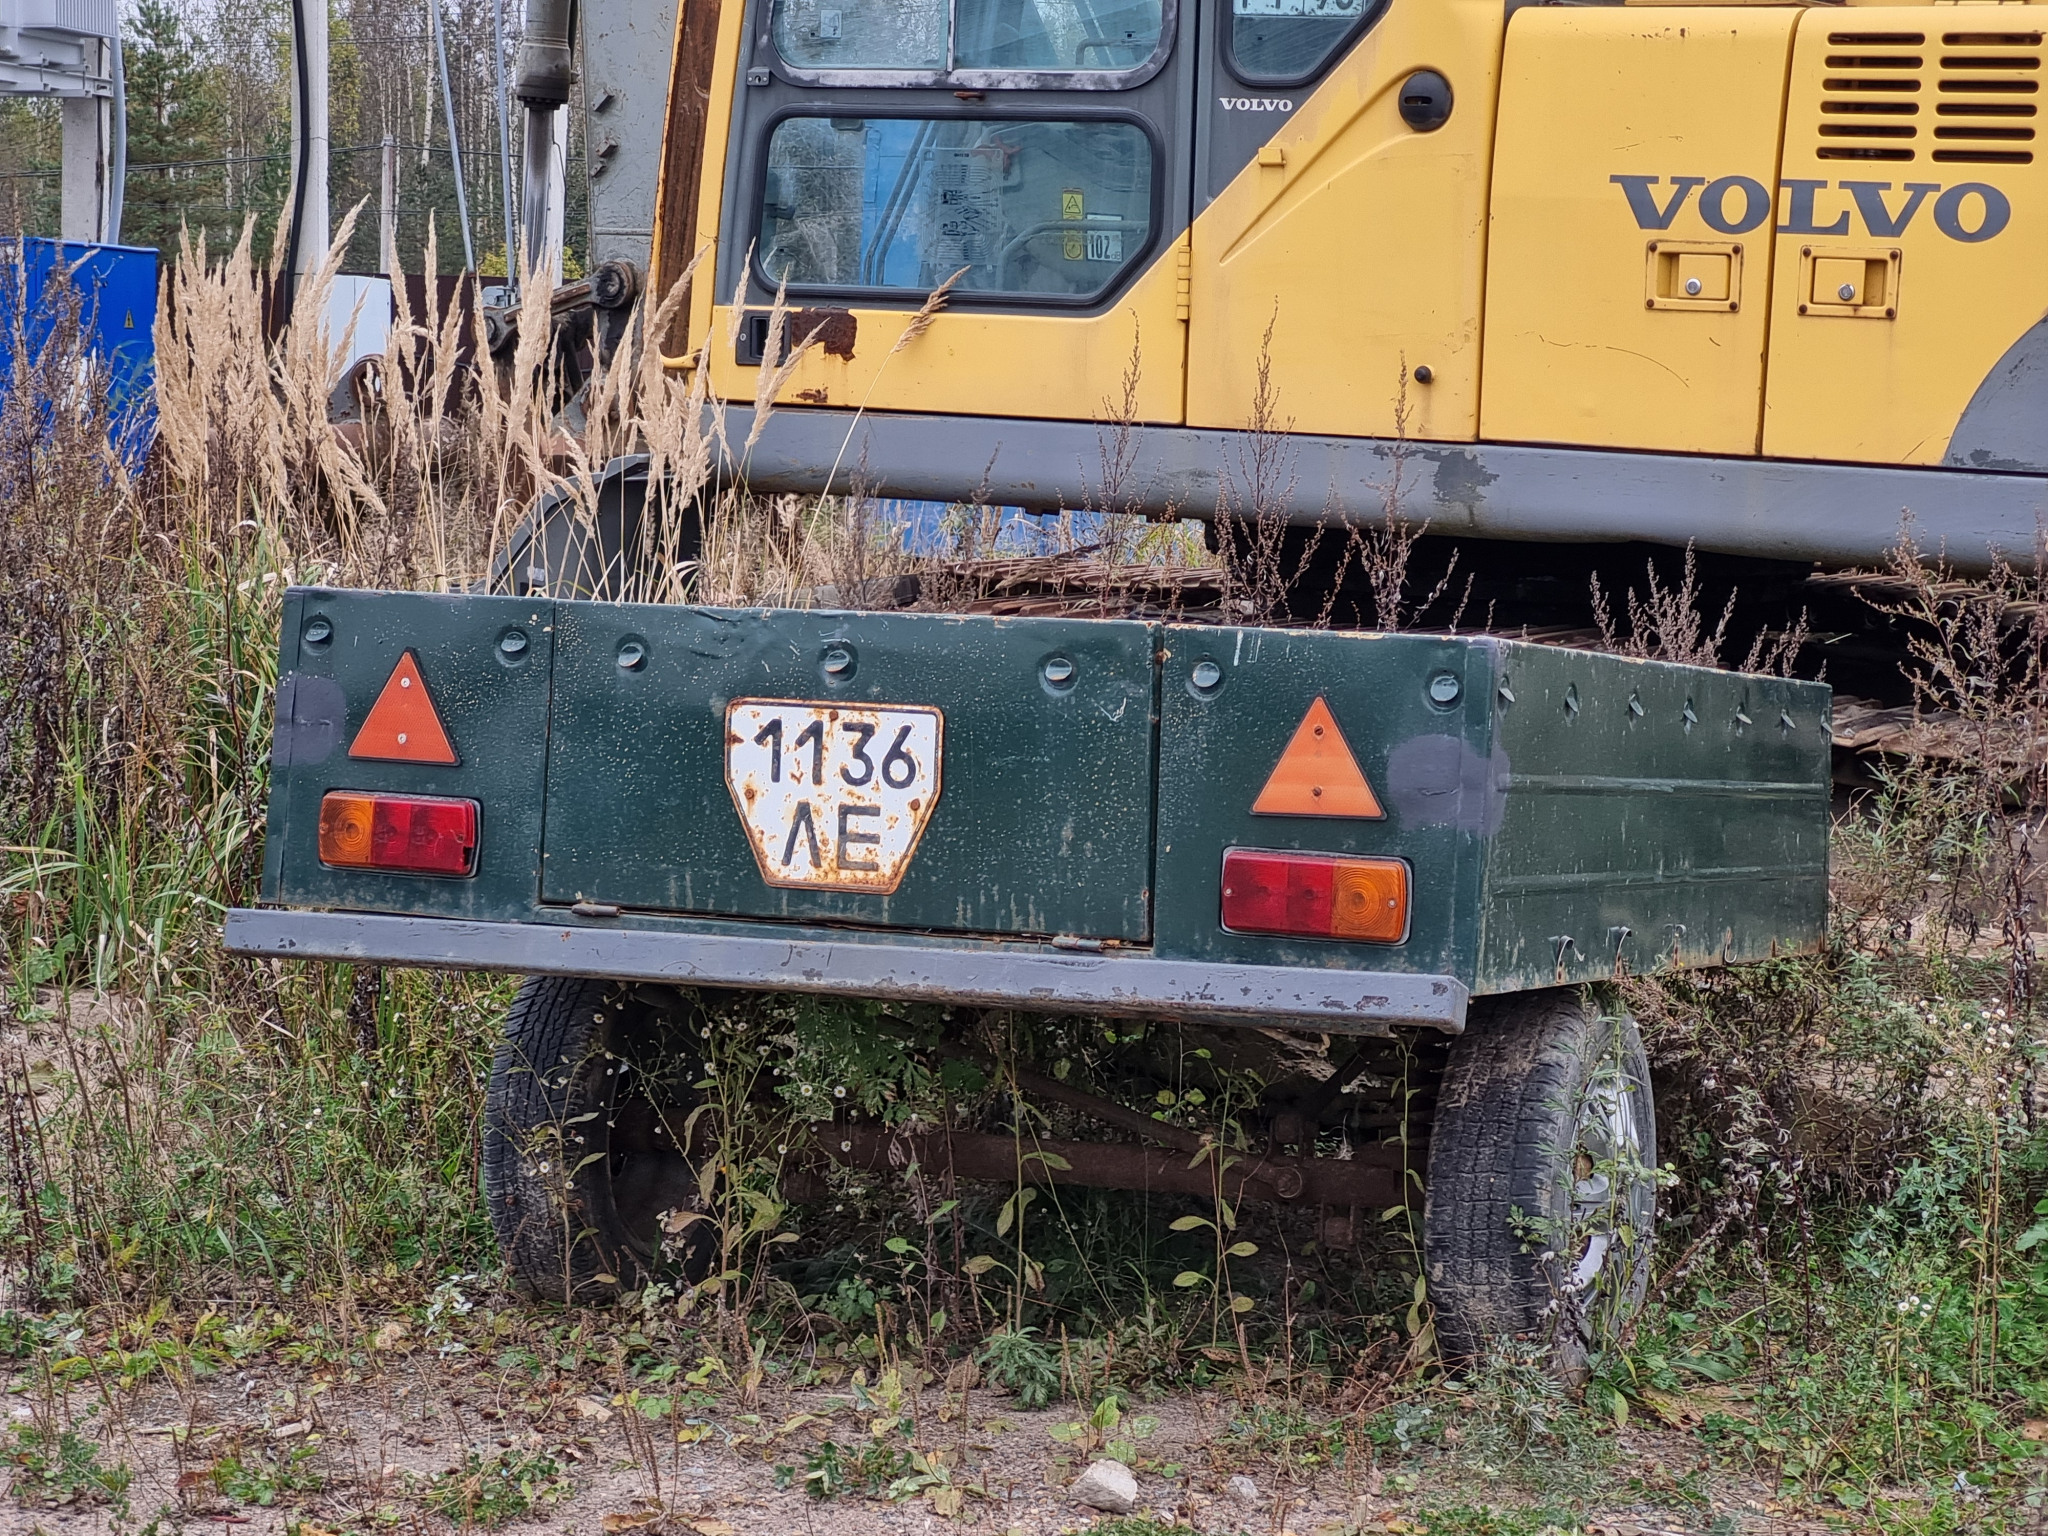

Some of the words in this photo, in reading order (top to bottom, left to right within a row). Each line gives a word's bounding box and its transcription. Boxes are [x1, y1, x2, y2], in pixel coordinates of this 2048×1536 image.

[1219, 97, 1293, 112] VOLVO
[1609, 174, 2012, 243] VOLVO
[1089, 234, 1110, 259] 102
[753, 718, 917, 790] 1136
